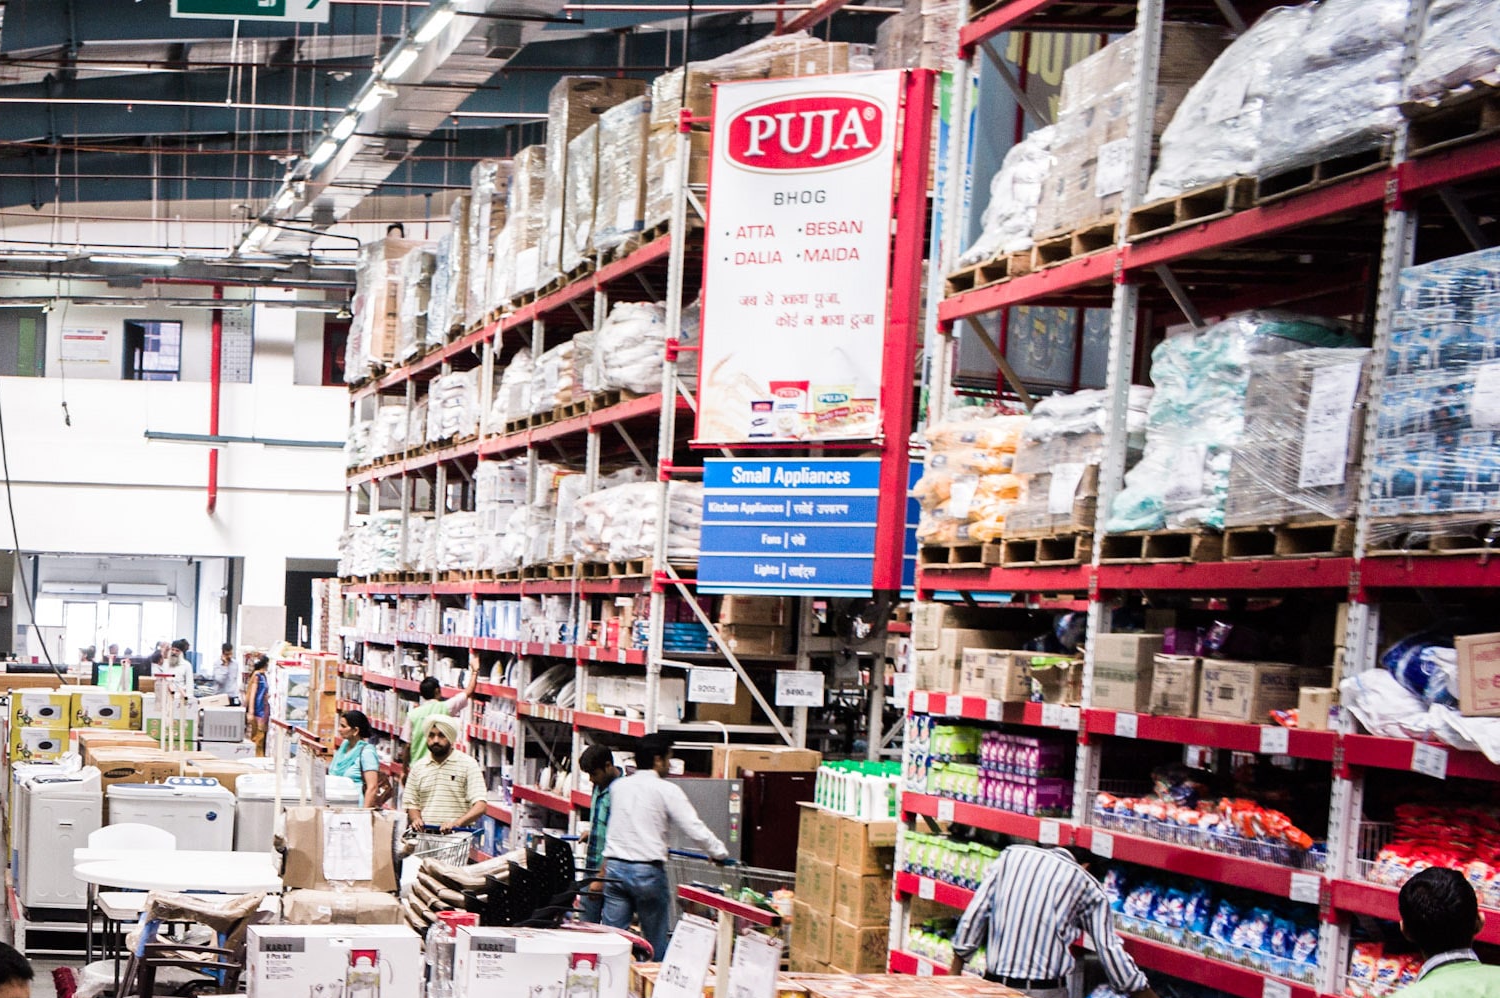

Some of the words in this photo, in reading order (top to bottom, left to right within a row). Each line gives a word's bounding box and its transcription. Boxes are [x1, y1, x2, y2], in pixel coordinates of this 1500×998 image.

[743, 106, 873, 159] PUJA
[773, 189, 827, 206] BHOG
[735, 224, 776, 240] ATTA
[804, 220, 864, 237] BESAN
[734, 250, 783, 266] DALIA
[803, 247, 860, 263] MAIDA
[731, 465, 771, 484] Small
[773, 466, 851, 488] Appliances
[707, 501, 740, 514] Kitchen
[739, 501, 785, 515] Appliances
[761, 533, 782, 546] Fans
[753, 563, 780, 577] Lights
[265, 943, 293, 951] KARAT
[477, 943, 505, 952] KARAT
